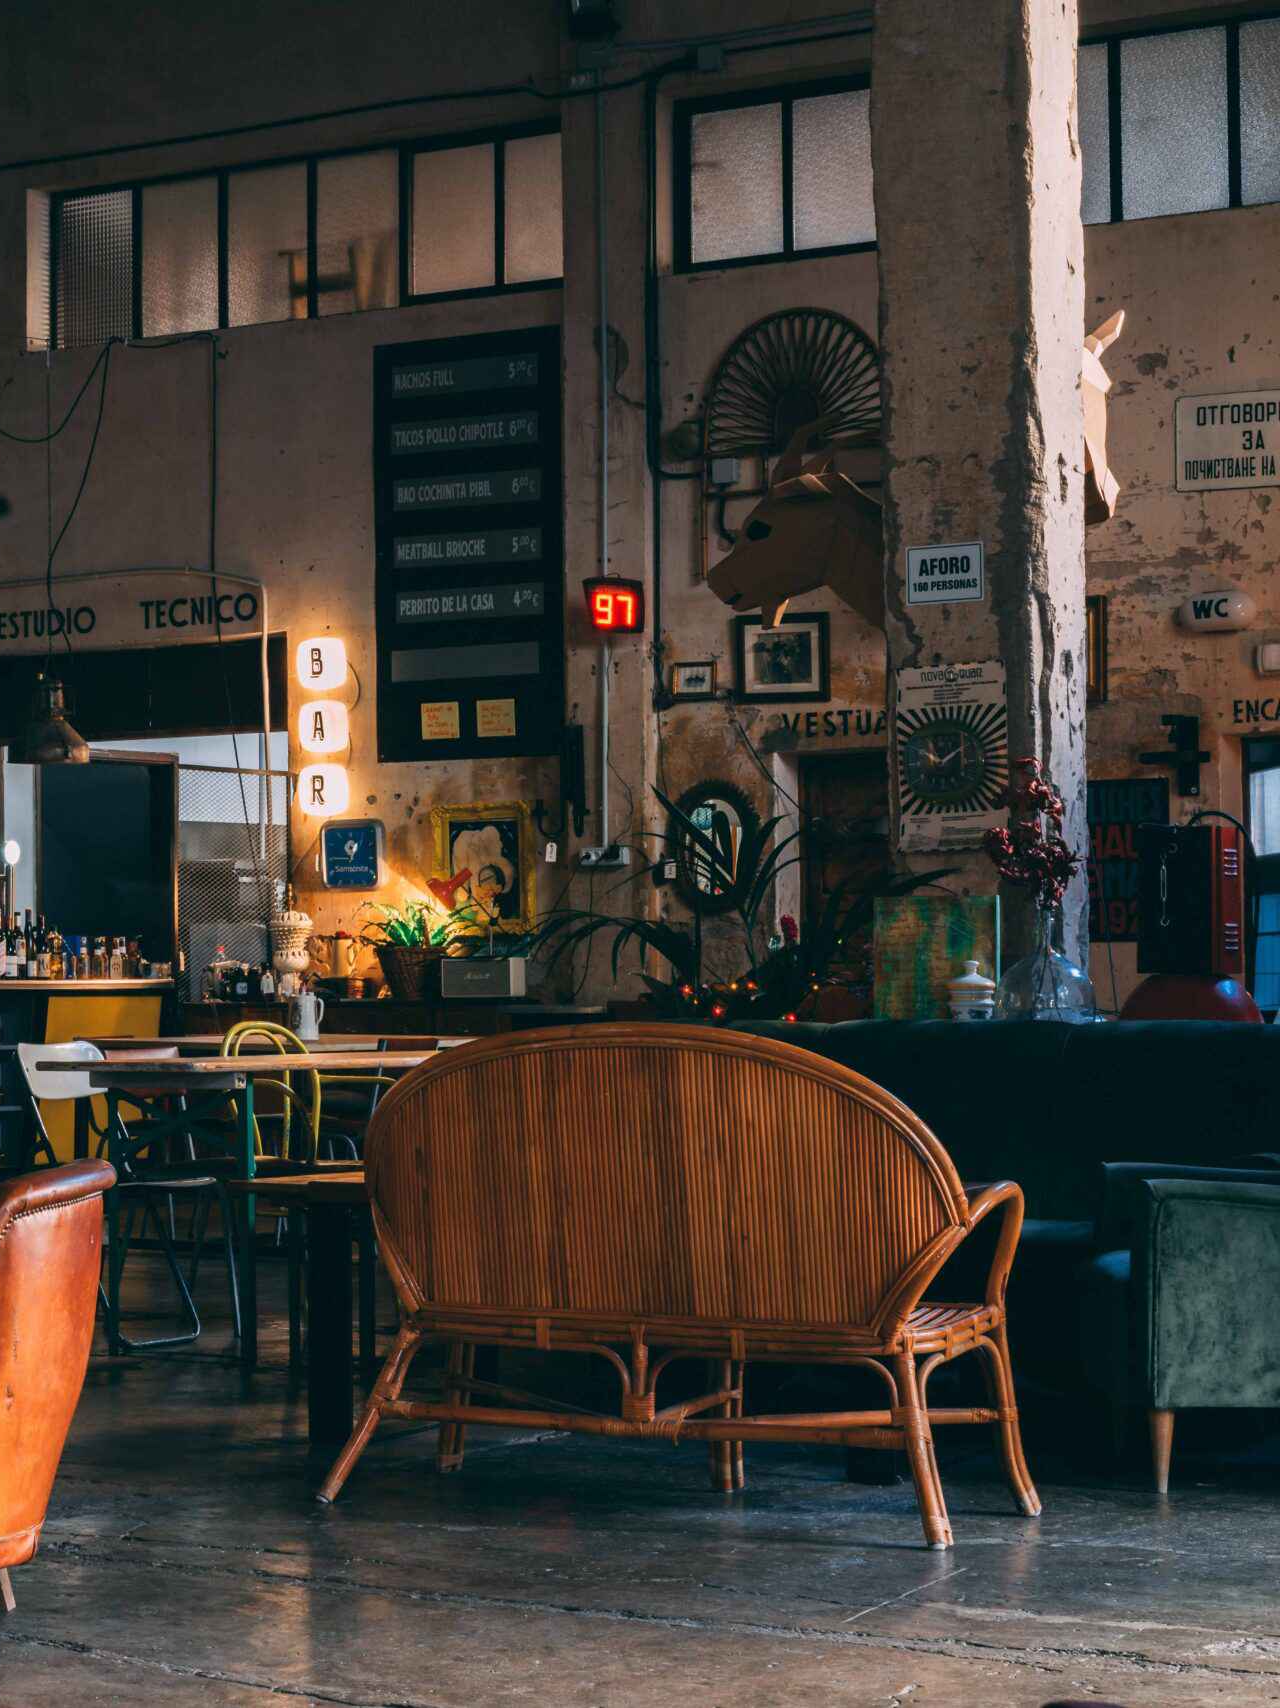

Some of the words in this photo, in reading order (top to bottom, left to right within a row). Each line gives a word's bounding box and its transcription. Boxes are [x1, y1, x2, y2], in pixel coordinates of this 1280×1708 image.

[394, 371, 431, 391] NACHOS
[433, 369, 455, 387] FULL
[1196, 401, 1280, 427] ОТГОВОР
[394, 428, 424, 448] TACOS
[426, 425, 457, 445] POLLO
[459, 421, 504, 441] CHIPOTLE
[1242, 429, 1265, 450] ЗА
[1184, 456, 1257, 480] ПОЧИСТВАНЕ
[1261, 455, 1276, 476] НА
[398, 486, 416, 504] BAO
[418, 482, 466, 501] COCHINITA
[470, 480, 492, 497] PIBIL
[398, 541, 444, 561] MEATBALL
[446, 539, 486, 558] BRIOCHE
[919, 555, 971, 577] AFORO
[913, 582, 928, 593] 160
[931, 578, 978, 592] PERSONAS
[140, 592, 258, 629] TECNICO
[400, 597, 439, 616] PERRITO
[442, 596, 454, 613] DE
[456, 595, 467, 612] LA
[470, 593, 494, 611] CASA
[596, 594, 632, 625] 97
[1192, 598, 1229, 619] WC
